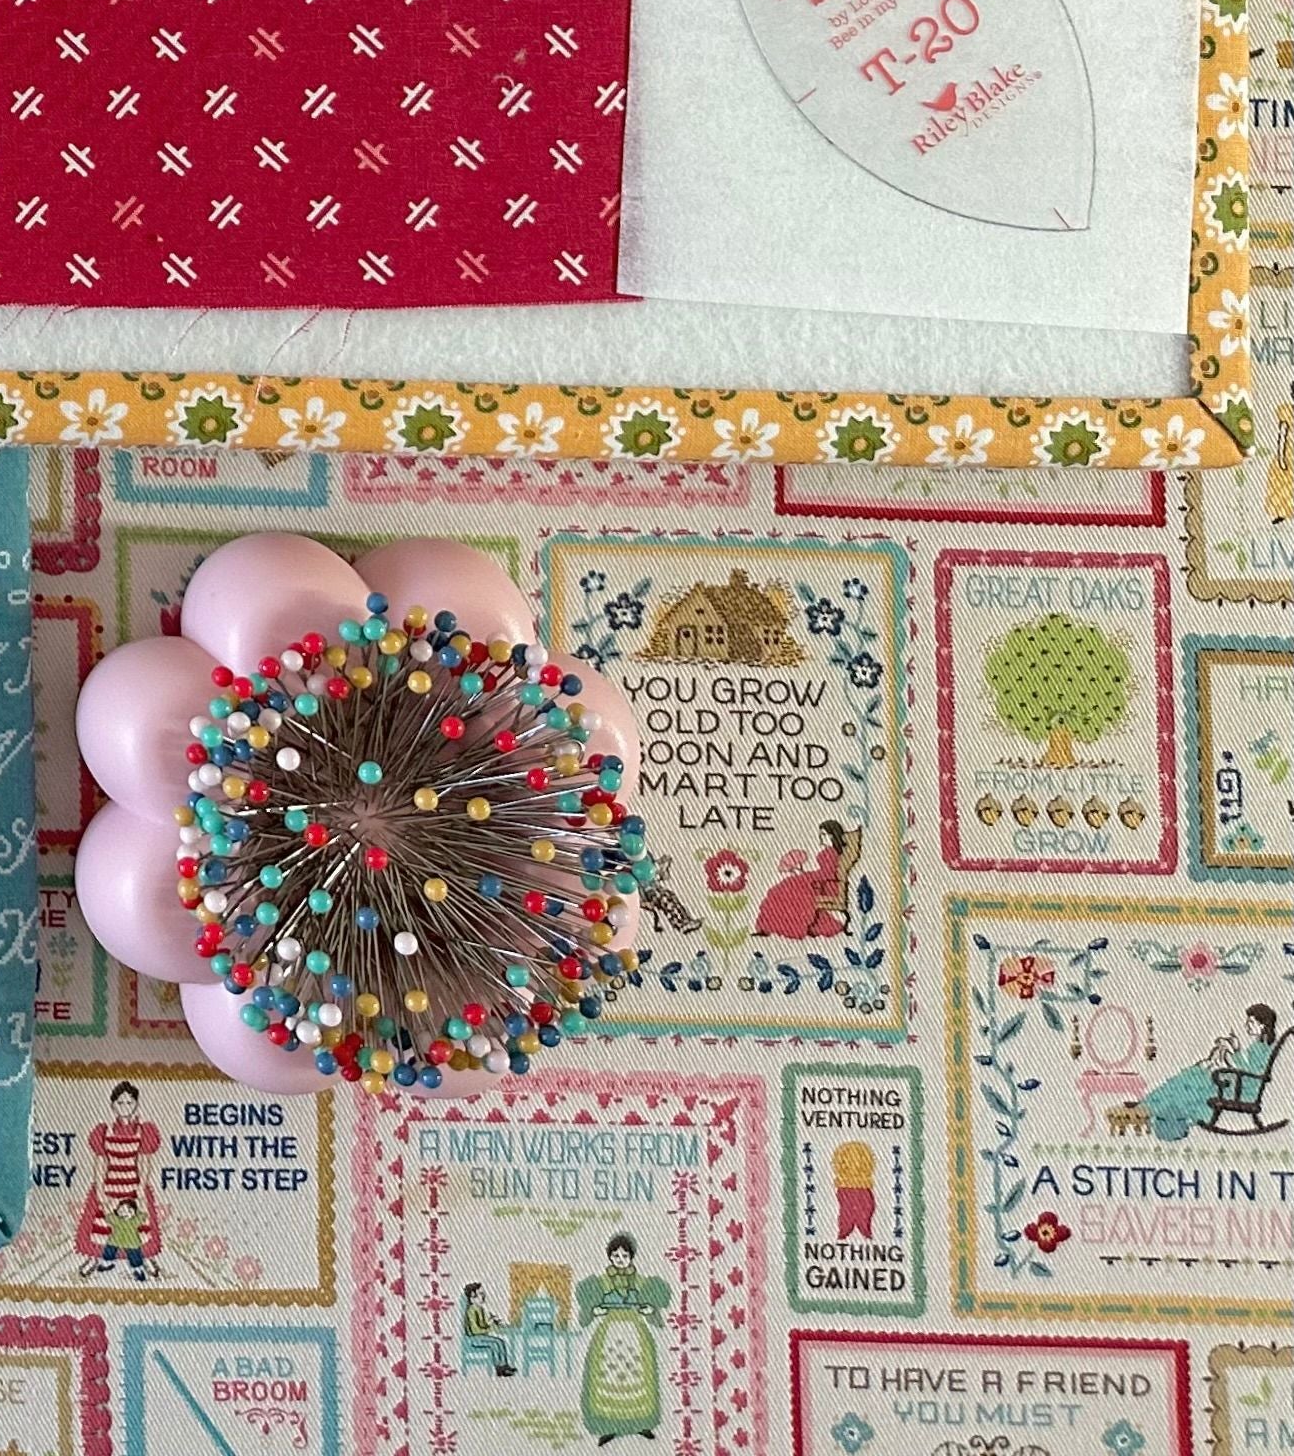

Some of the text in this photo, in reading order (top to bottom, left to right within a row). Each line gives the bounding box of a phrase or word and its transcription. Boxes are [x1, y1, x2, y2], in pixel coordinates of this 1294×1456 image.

[829, 10, 849, 28] by
[830, 27, 859, 51] Bee
[858, 14, 875, 29] in
[910, 63, 1026, 156] Riley Blake
[142, 456, 217, 478] ROOM
[965, 574, 1144, 610] GREAT OAKS
[622, 676, 826, 708] YOU GROW
[647, 708, 805, 736] OLD TOO
[746, 742, 829, 769] AND
[639, 772, 844, 804] MART TOO
[973, 771, 1144, 794] FROM LITTLE
[679, 804, 775, 831] LATE
[1014, 828, 1107, 854] GROW
[802, 1087, 902, 1107] NOTHING
[185, 1103, 284, 1126] BEGINS
[802, 1110, 904, 1130] VENTURED
[171, 1136, 297, 1159] WITH THE
[420, 1130, 699, 1167] A MAN WORKS FROM
[161, 1168, 308, 1191] FIRST STEP
[471, 1168, 654, 1202] SUN TO SUN
[1032, 1165, 1060, 1196] A
[1072, 1165, 1200, 1200] STITCH
[1217, 1170, 1256, 1201] IN
[1079, 1205, 1214, 1245] SAVES
[805, 1243, 904, 1263] NOTHING
[806, 1267, 905, 1292] GAINED
[825, 1366, 1150, 1397] TO HAVE A FRIEND
[894, 1401, 1083, 1428] YOU MUST
